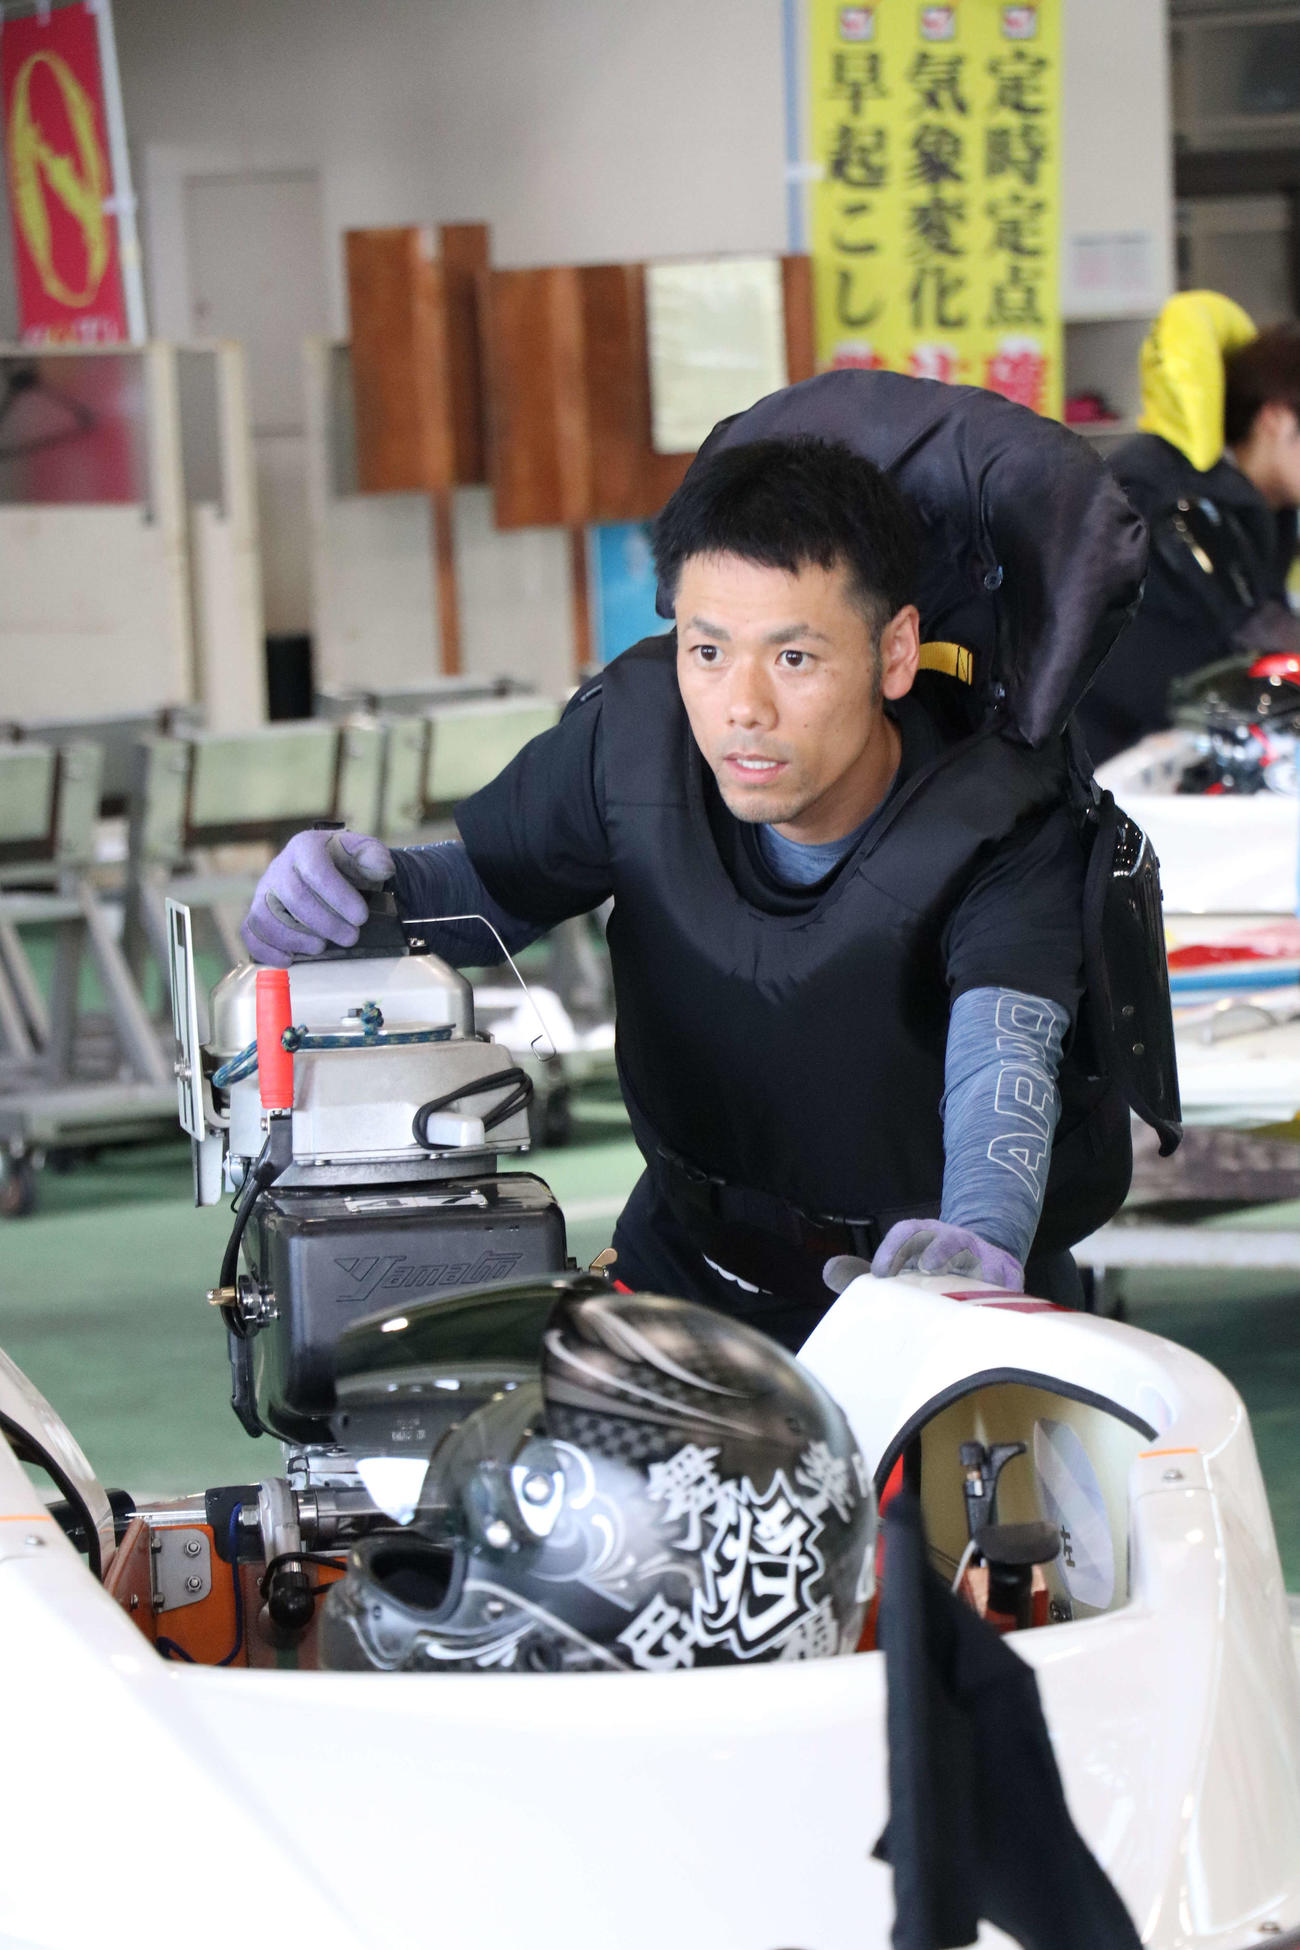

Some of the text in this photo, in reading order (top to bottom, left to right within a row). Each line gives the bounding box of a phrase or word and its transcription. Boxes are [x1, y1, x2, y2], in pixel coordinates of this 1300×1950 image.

[829, 50, 888, 329] 早起こし
[906, 50, 969, 331] 気象変化
[984, 49, 1048, 329] 定時定点
[986, 987, 1056, 1202] ARMO
